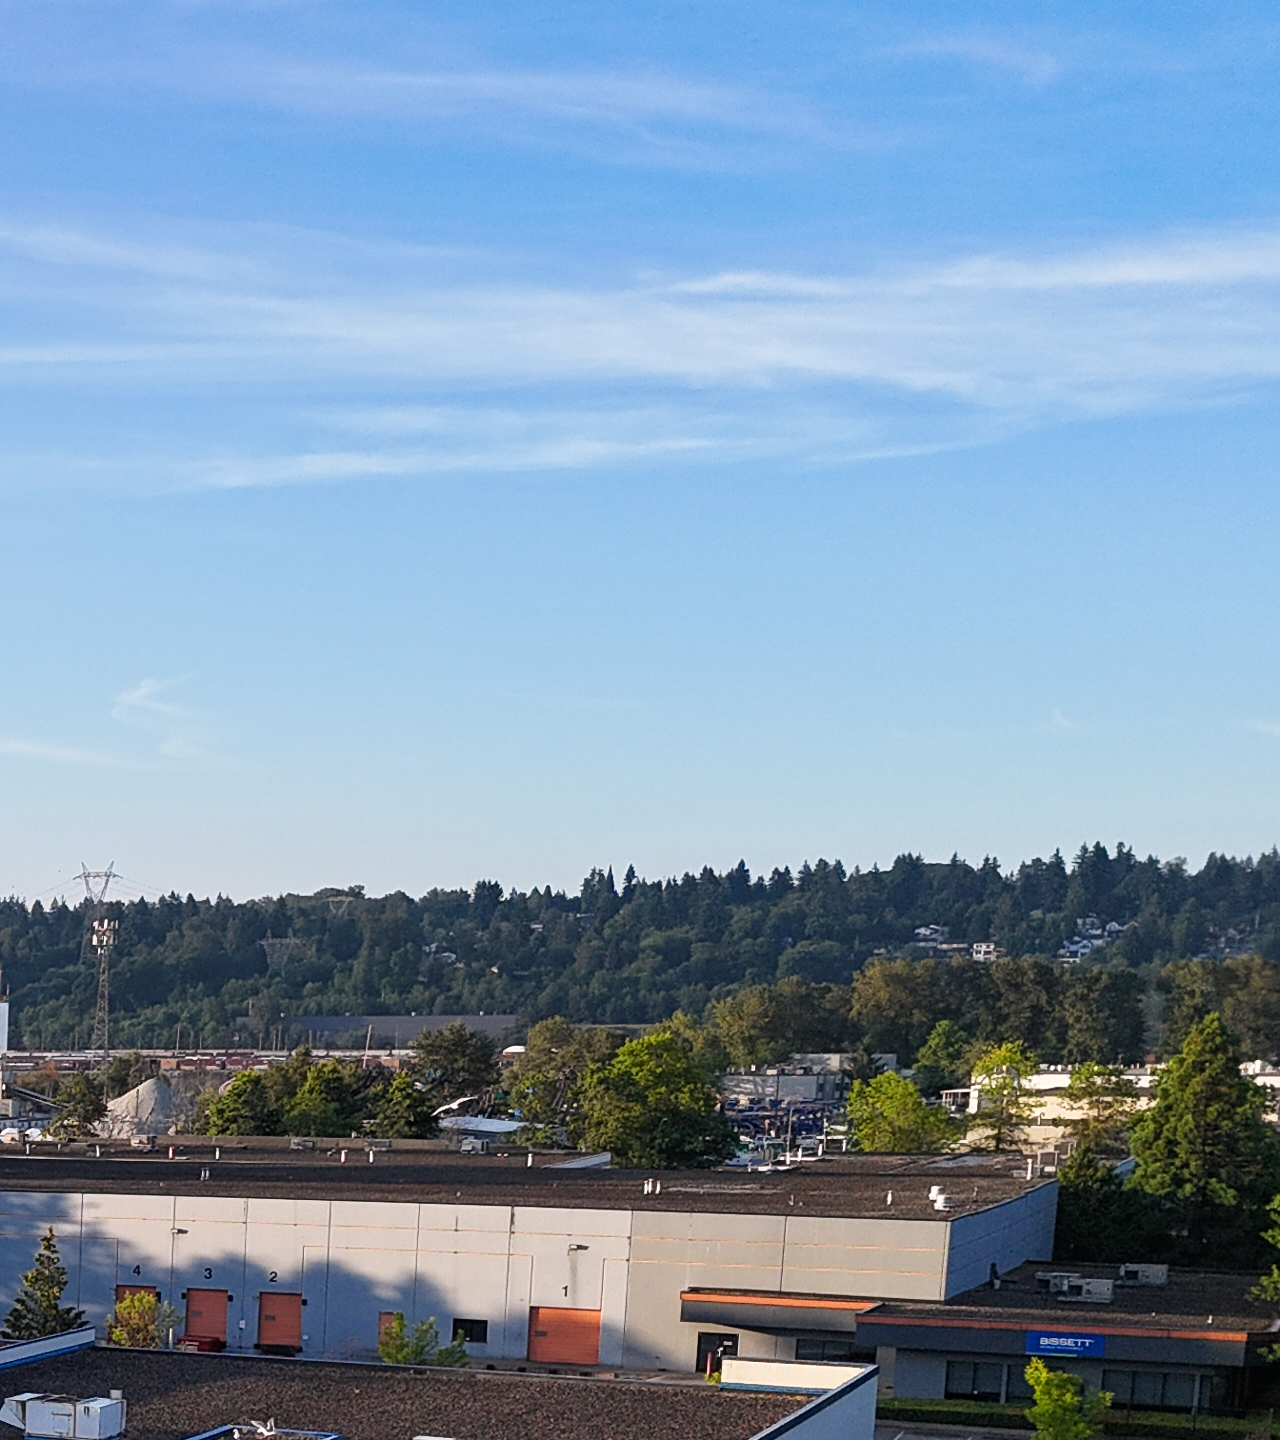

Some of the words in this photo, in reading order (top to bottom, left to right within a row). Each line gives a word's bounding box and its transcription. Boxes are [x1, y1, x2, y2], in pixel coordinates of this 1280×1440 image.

[132, 1264, 142, 1276] 4
[204, 1267, 213, 1279] 3
[268, 1271, 278, 1282] 2
[561, 1285, 568, 1297] 1
[1040, 1338, 1092, 1346] BISSETT
